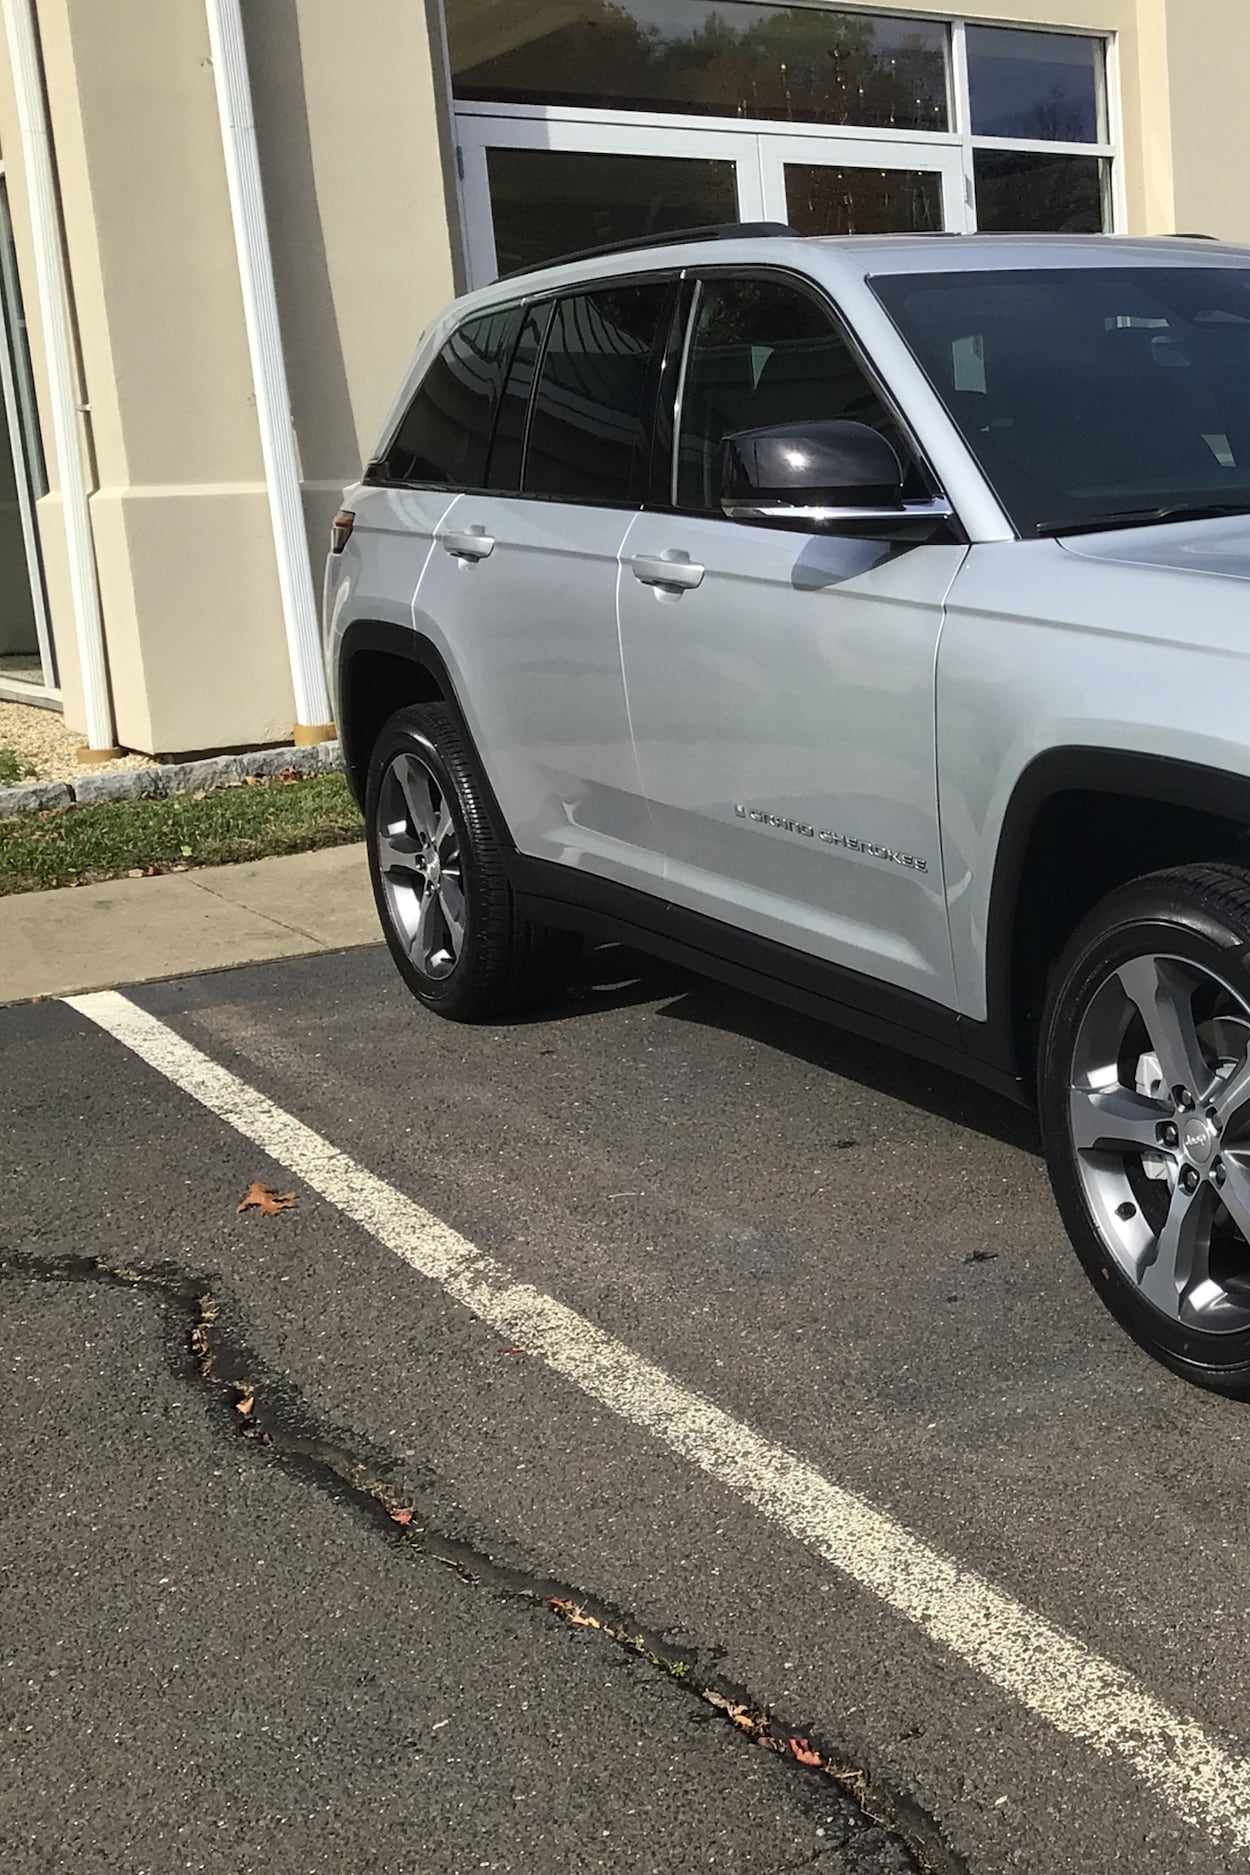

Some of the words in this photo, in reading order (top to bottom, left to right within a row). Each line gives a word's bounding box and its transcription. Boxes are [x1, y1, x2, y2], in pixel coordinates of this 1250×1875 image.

[750, 809, 814, 837] GRAND
[819, 830, 929, 873] CHEROKEE
[1185, 1134, 1207, 1146] Jeep
